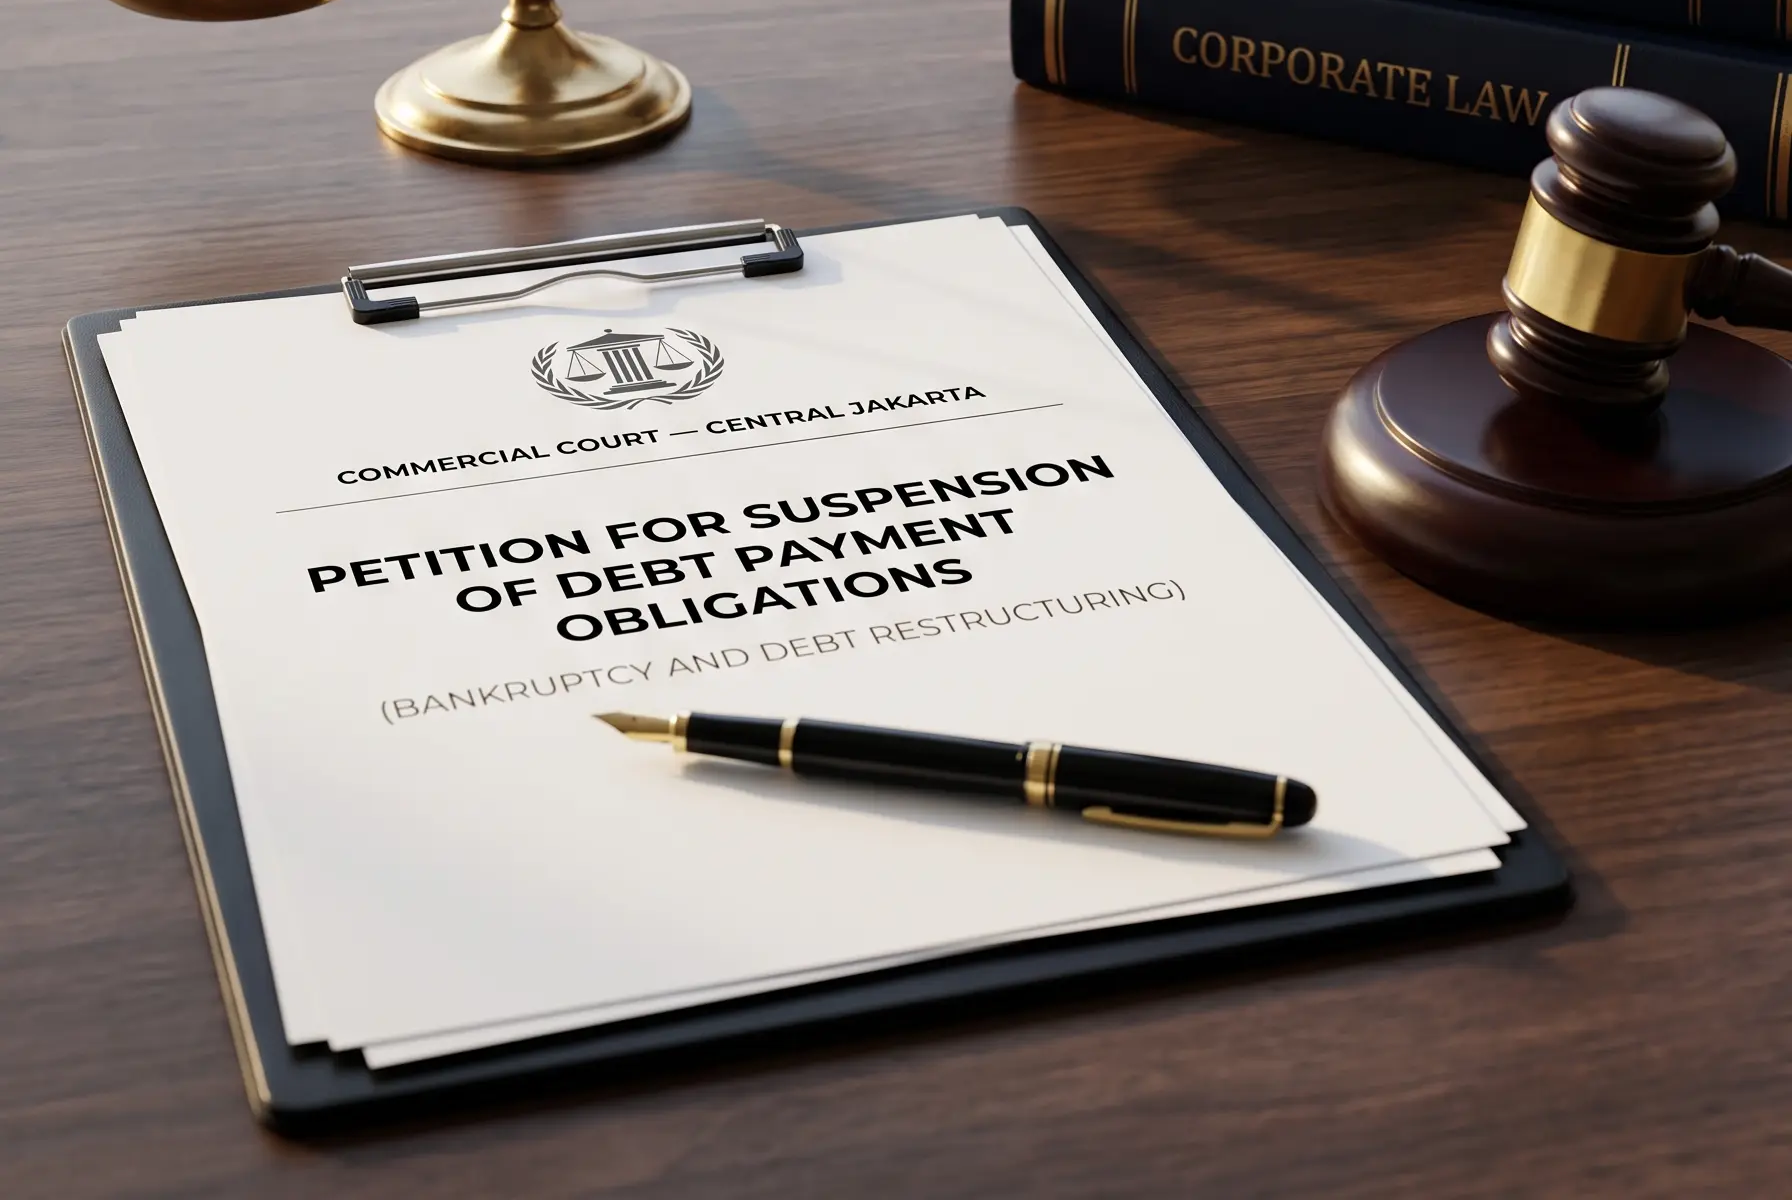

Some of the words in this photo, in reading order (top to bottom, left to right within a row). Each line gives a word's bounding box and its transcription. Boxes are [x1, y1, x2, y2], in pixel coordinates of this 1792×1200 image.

[1172, 26, 1433, 106] CORPORATE
[1447, 74, 1550, 126] LAW
[337, 445, 551, 485] COMMERCIAL
[556, 429, 659, 455] COURT
[705, 405, 846, 434] CENTRAL
[848, 386, 987, 416] JAKARTA
[307, 529, 591, 594] PETITION
[605, 511, 732, 550] FOR
[742, 454, 1115, 529] SUSPENSION
[456, 577, 537, 613] OF
[555, 551, 716, 600] DEBT
[734, 507, 1014, 573] PAYMENT
[556, 558, 973, 642] OBLIGATIONS
[381, 661, 652, 725] (BANKRUPTCY
[669, 648, 749, 677] AND
[759, 629, 856, 662] DEBT
[869, 579, 1186, 645] RESTRUCTURING)
